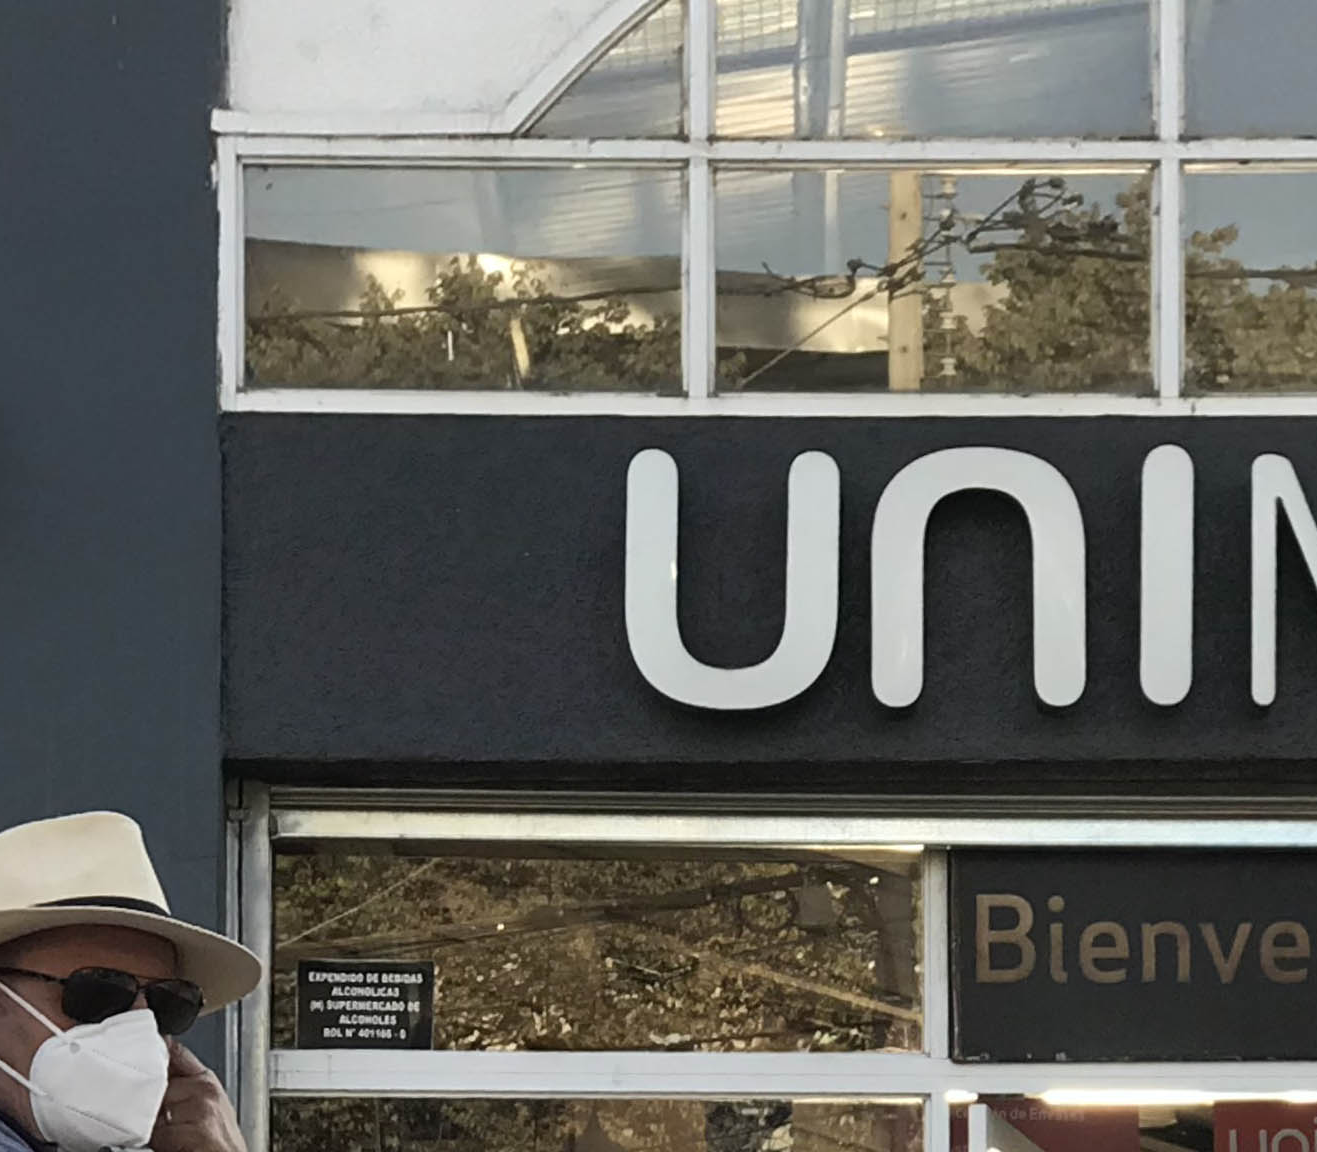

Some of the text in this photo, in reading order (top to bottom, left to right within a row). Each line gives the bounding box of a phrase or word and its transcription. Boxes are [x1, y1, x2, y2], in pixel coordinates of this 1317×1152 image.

[308, 971, 423, 983] EXPENDIDO DE BEBIDAS
[326, 1000, 405, 1012] SUPERMERCADO
[407, 1001, 420, 1012] DE
[339, 1014, 397, 1025] ALCOHOLES
[323, 1027, 343, 1038] ROL
